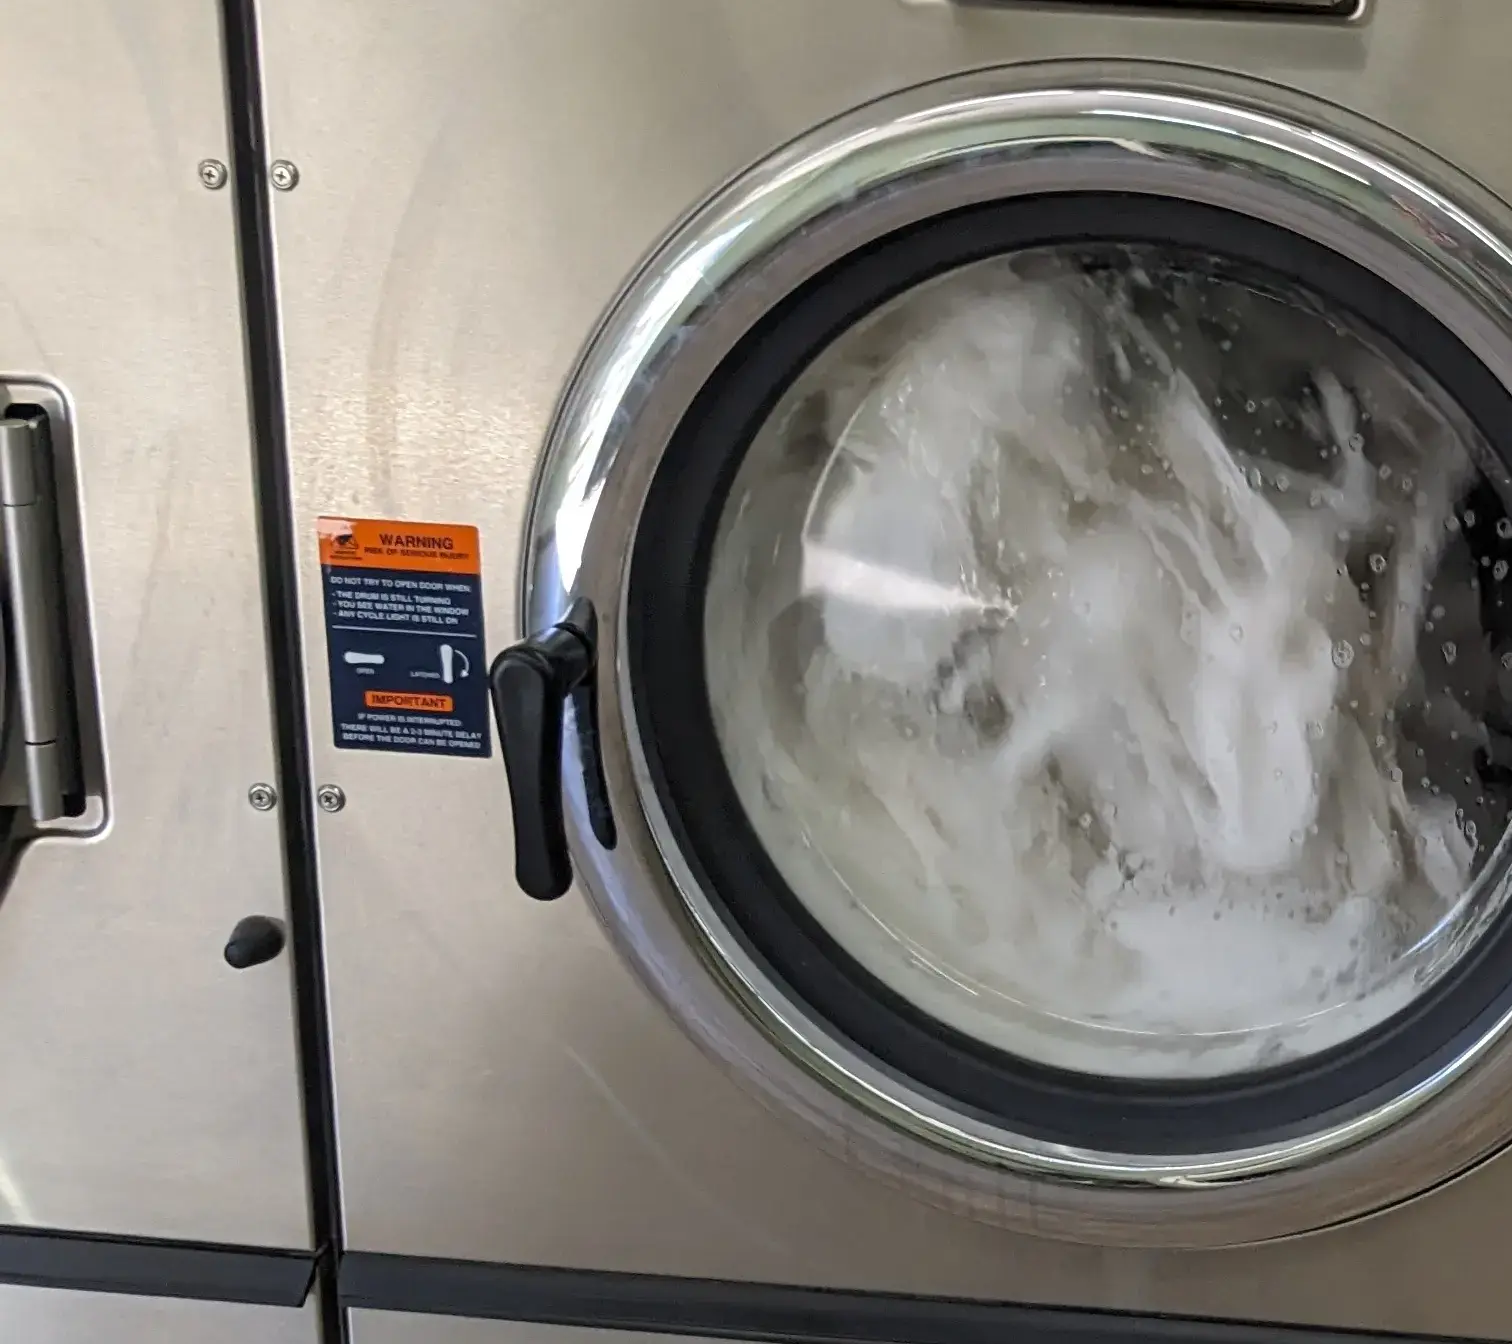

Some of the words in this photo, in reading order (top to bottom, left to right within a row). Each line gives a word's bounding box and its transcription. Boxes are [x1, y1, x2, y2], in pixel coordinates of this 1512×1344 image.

[379, 533, 454, 550] WARNING
[330, 576, 343, 585] DO
[344, 576, 361, 586] NOT
[363, 577, 380, 587] TRY
[381, 578, 393, 587] TO
[394, 579, 418, 589] OPEN
[419, 581, 444, 591] DOOR
[335, 590, 353, 599] THE
[390, 593, 413, 604] STILL
[337, 599, 356, 609] YOU
[375, 601, 405, 612] WATER
[416, 604, 433, 614] THE
[433, 605, 470, 616] WINDOW
[371, 693, 447, 709] IMPORTANT
